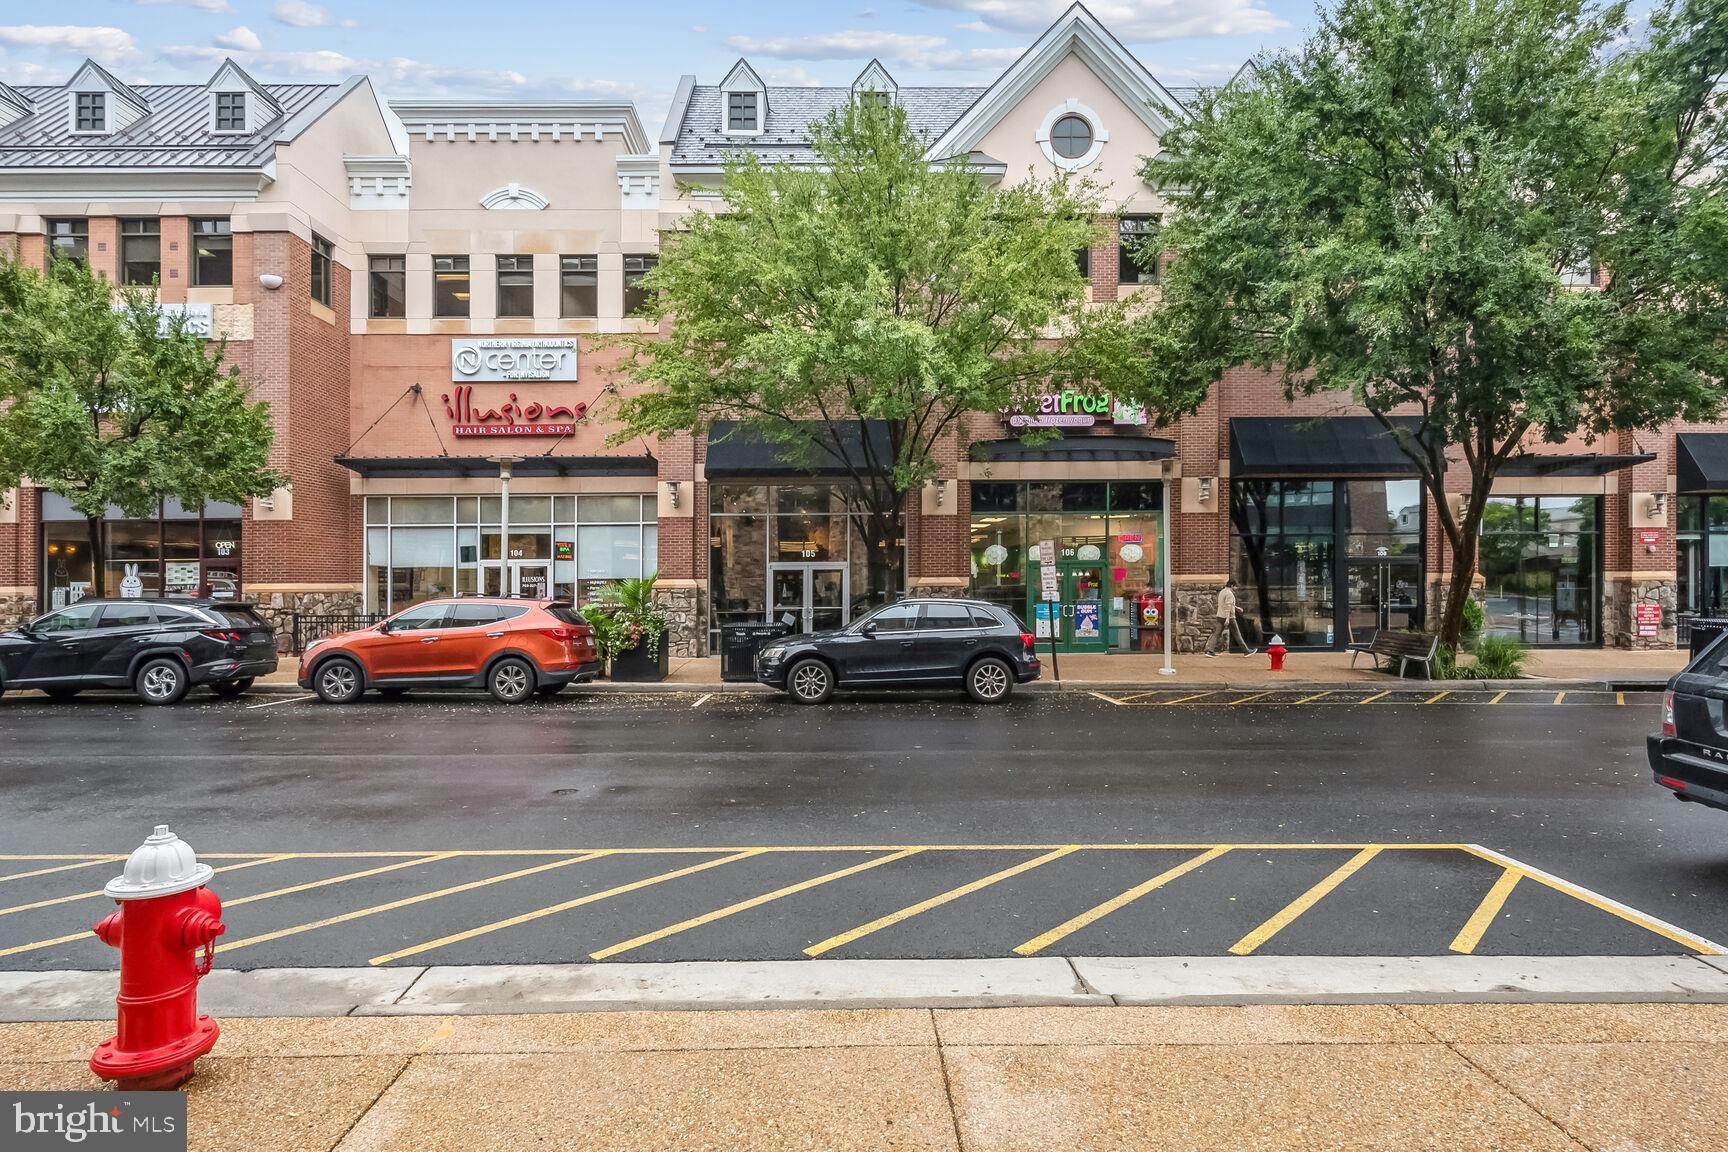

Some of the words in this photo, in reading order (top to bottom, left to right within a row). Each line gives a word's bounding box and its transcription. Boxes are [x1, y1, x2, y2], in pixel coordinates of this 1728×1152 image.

[486, 346, 566, 370] center
[441, 386, 586, 424] illusions
[490, 426, 532, 434] SALON
[548, 425, 571, 433] SPA
[215, 541, 235, 549] OPEN
[217, 548, 230, 556] 103
[510, 549, 523, 557] 104
[801, 550, 815, 558] 105
[1061, 548, 1075, 556] 106
[1703, 748, 1728, 760] RA
